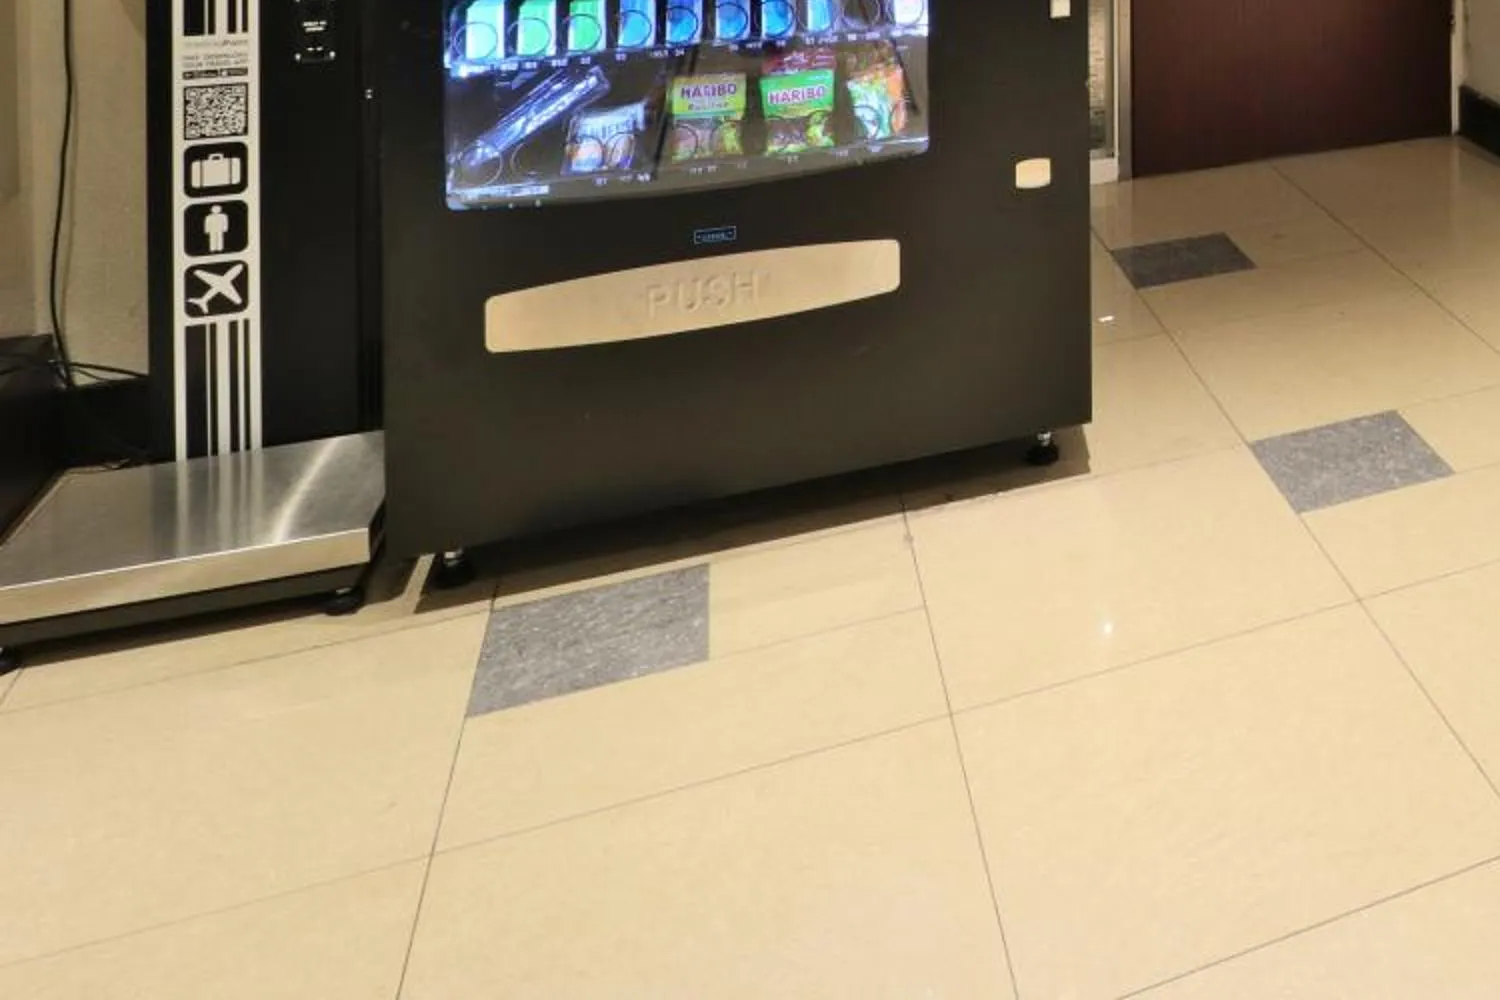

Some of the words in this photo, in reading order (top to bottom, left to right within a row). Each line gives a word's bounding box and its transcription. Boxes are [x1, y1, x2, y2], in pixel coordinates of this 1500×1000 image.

[680, 82, 738, 100] HARIBO
[768, 85, 827, 105] HARIBO
[644, 269, 762, 320] PUSH
